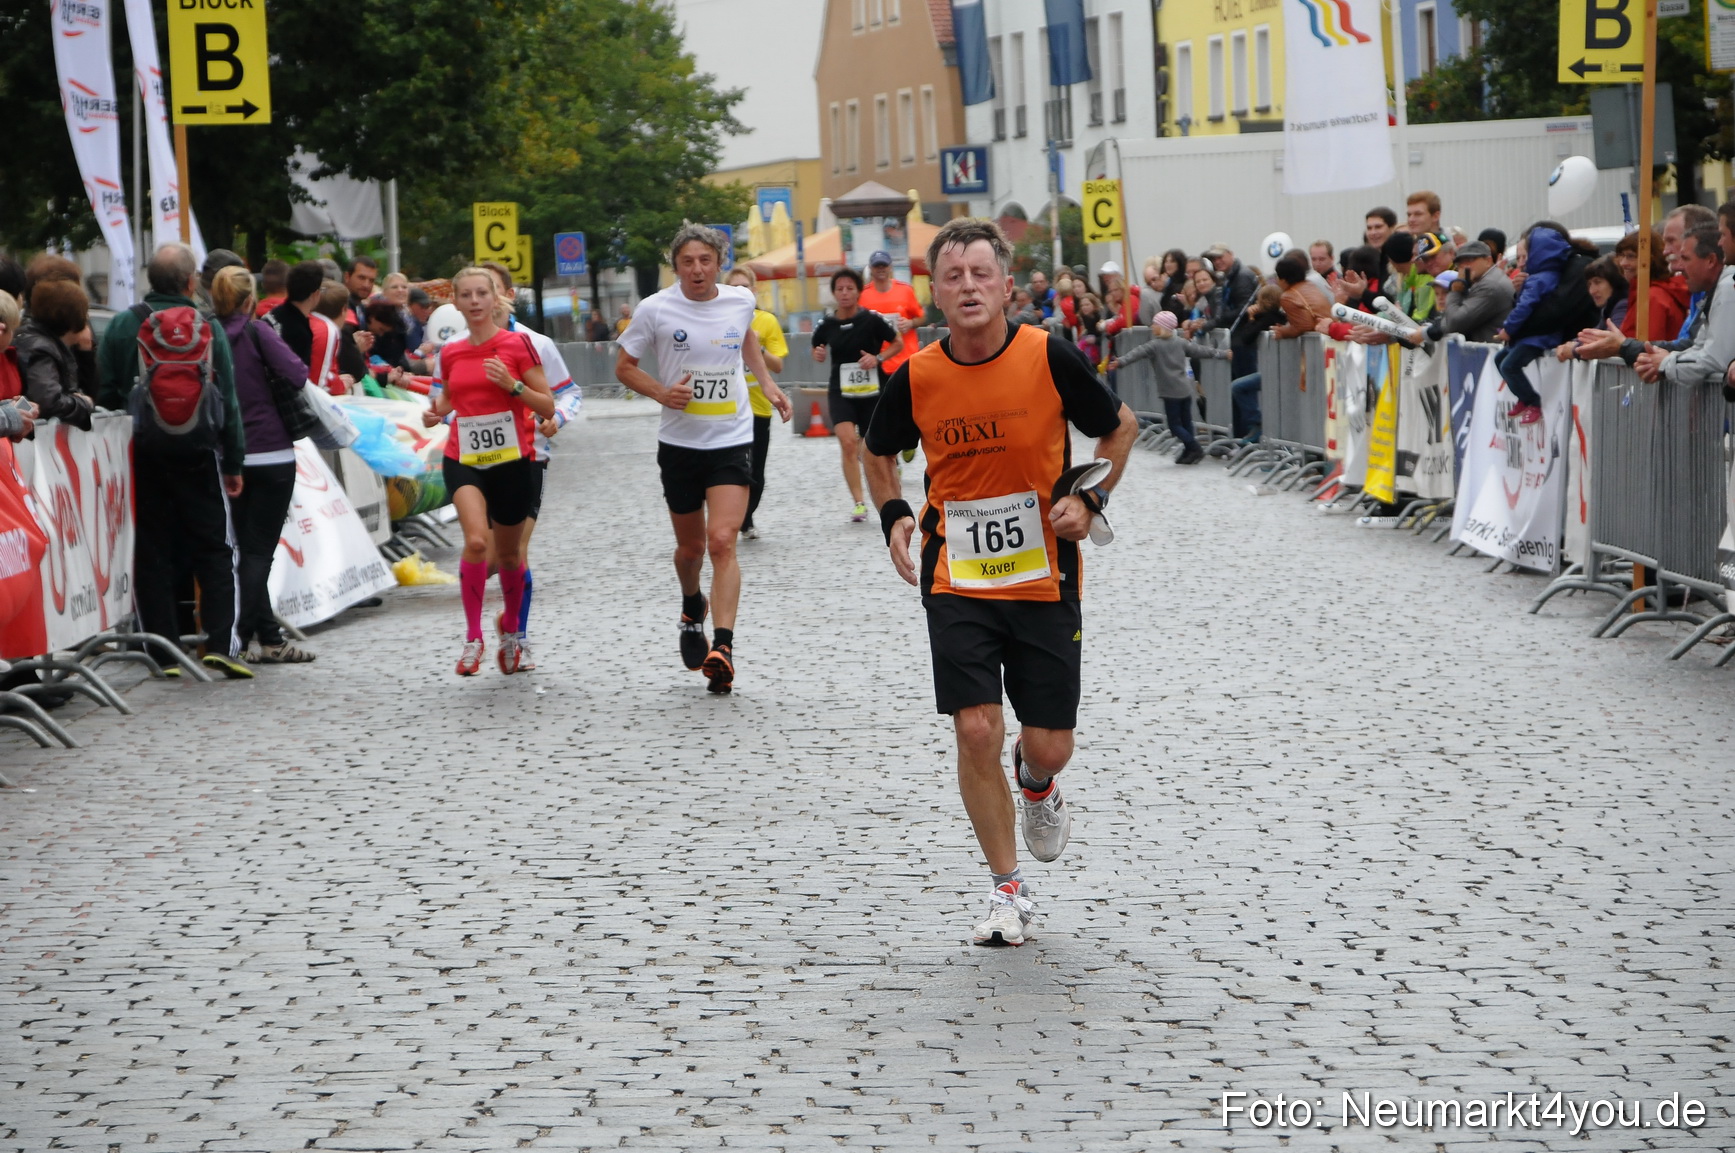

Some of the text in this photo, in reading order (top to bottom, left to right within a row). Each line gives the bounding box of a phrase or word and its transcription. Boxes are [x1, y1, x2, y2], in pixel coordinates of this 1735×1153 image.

[1584, 0, 1632, 49] B
[194, 22, 244, 91] B
[1086, 181, 1118, 194] Block
[479, 205, 511, 217] Block
[1093, 198, 1114, 228] C
[485, 221, 506, 252] C
[1352, 312, 1376, 327] BMW
[703, 369, 730, 377] Neumarkt
[848, 371, 871, 384] 484
[693, 378, 728, 399] 573
[469, 427, 505, 450] 396
[943, 421, 1005, 446] OEXL
[476, 453, 502, 463] Kristin
[947, 502, 1021, 518] PARTL Neumarkt
[965, 515, 1025, 554] 165
[980, 560, 1016, 576] Xaver
